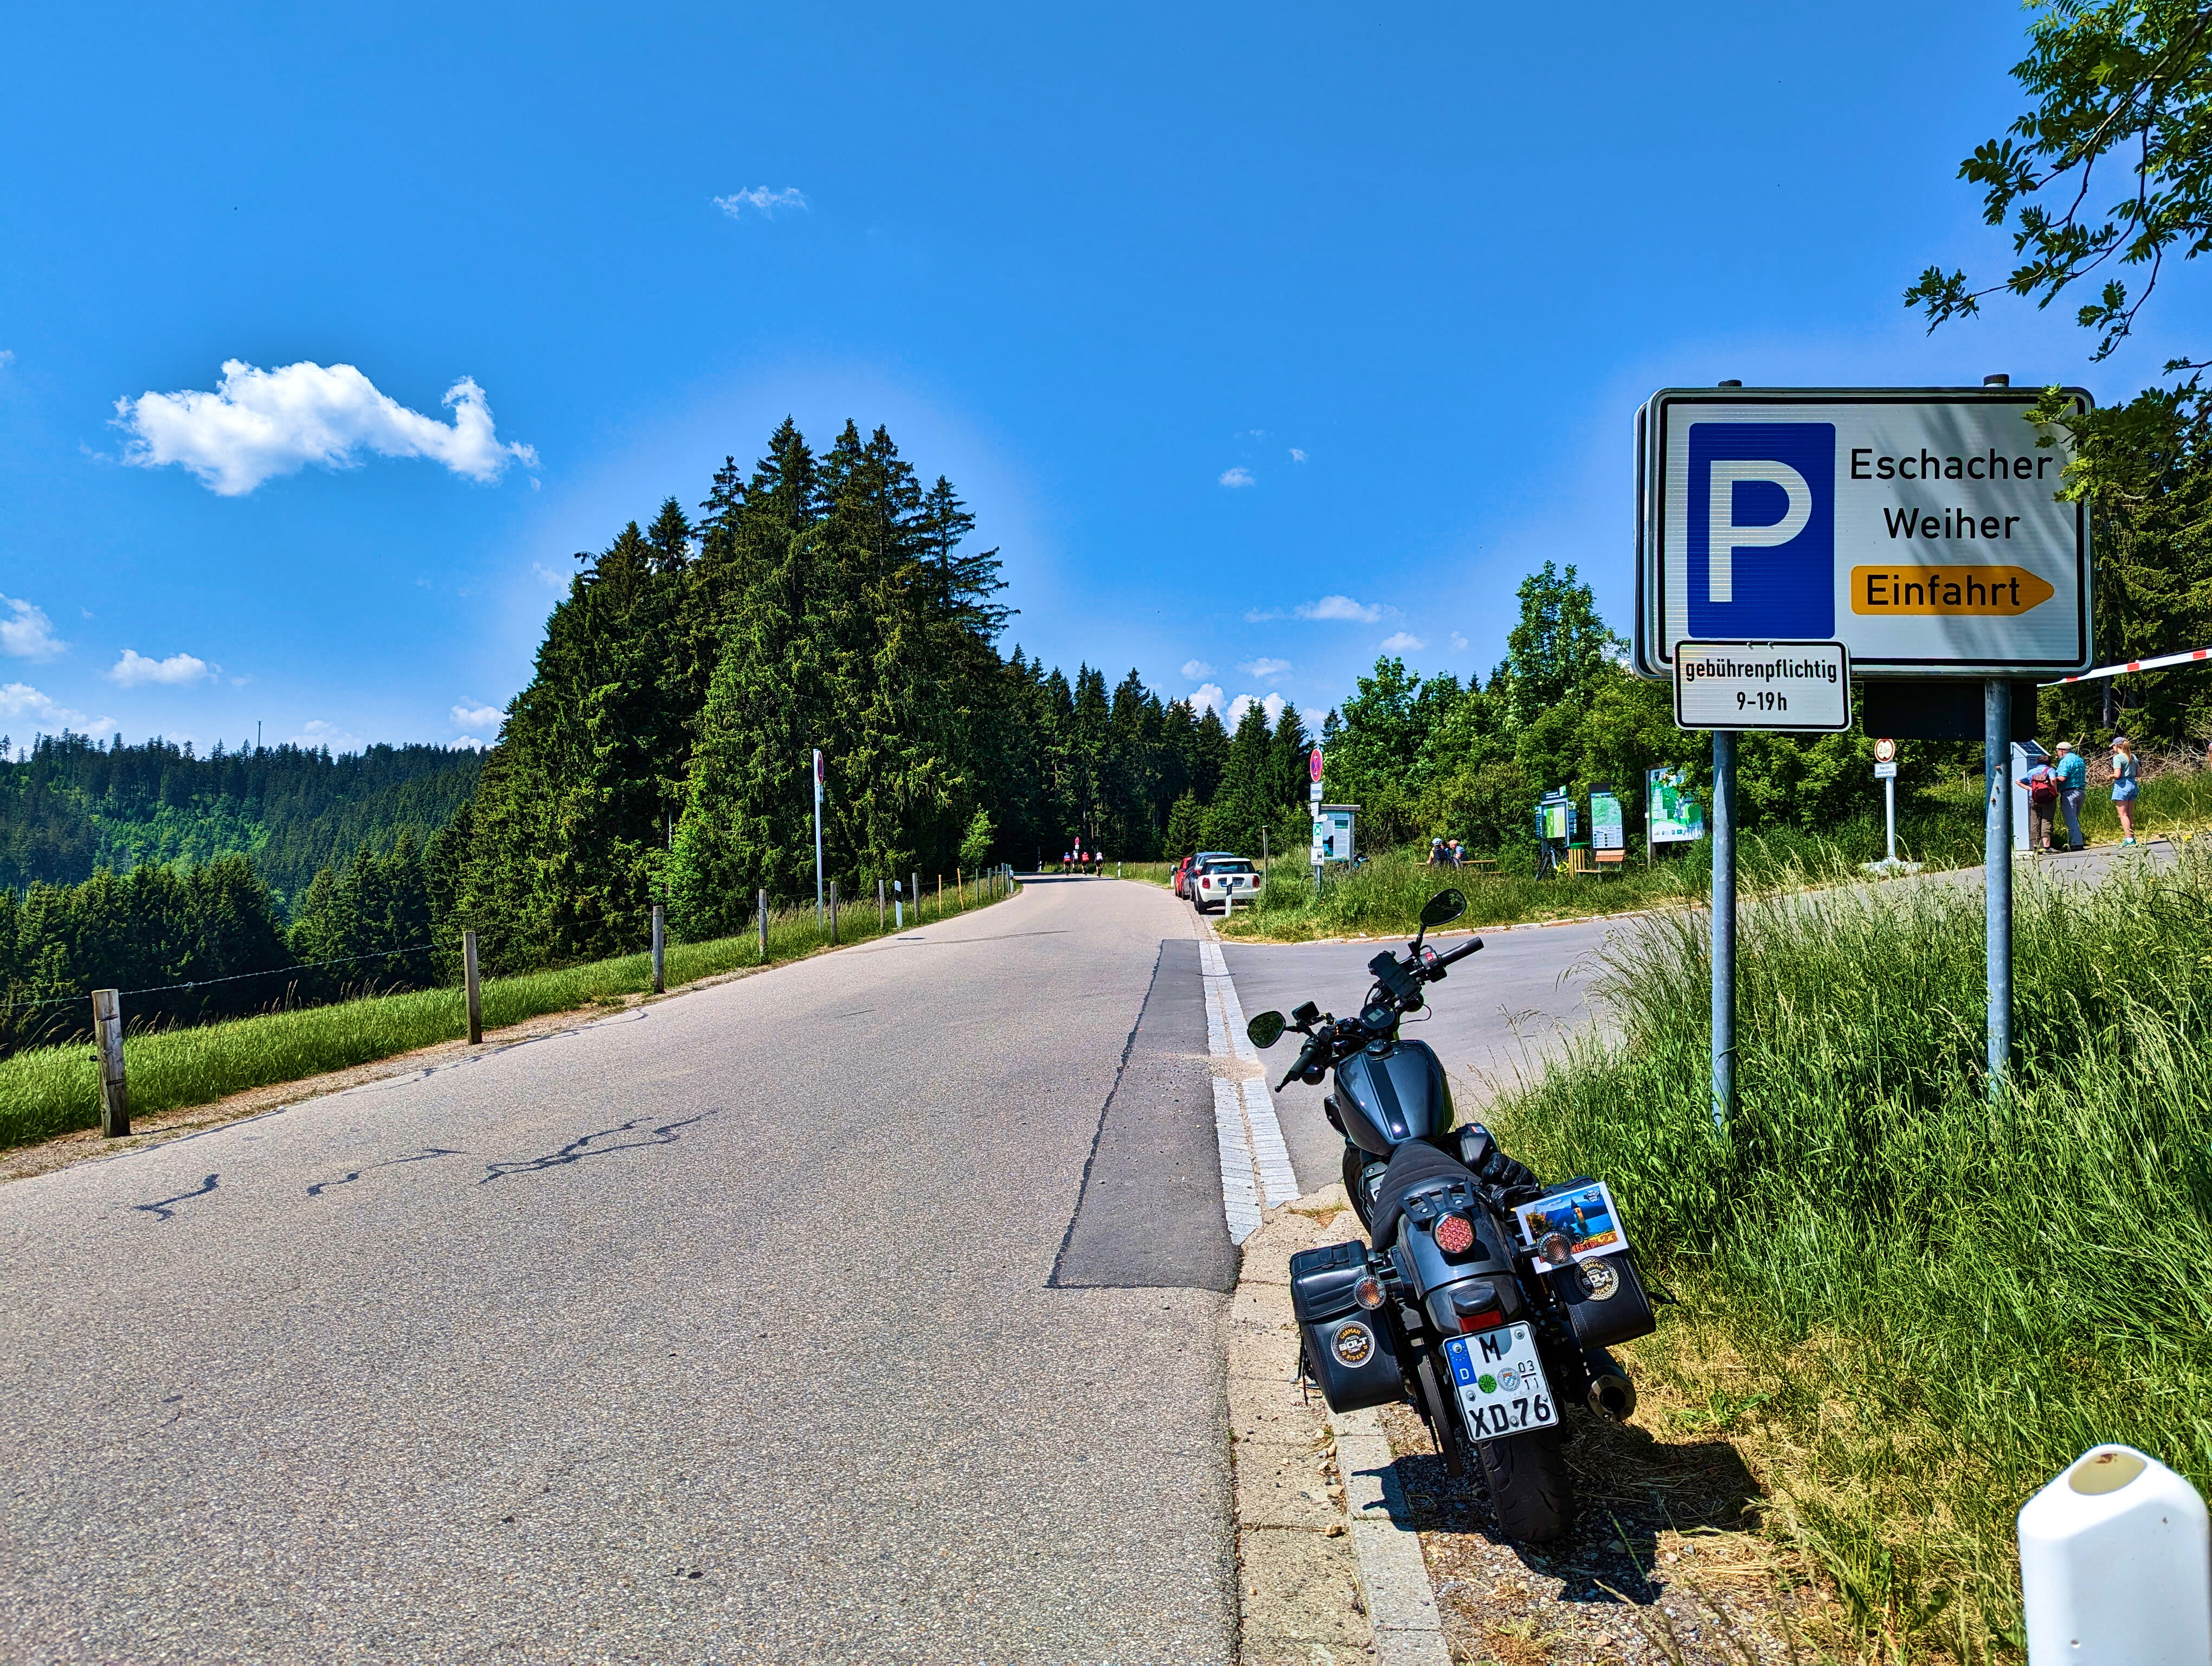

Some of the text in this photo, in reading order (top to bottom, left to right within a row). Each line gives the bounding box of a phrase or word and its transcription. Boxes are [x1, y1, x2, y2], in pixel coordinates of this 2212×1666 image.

[1851, 448, 2053, 480] Eschacher
[1709, 460, 1812, 603] P
[1883, 508, 2021, 539] Weiher
[1867, 574, 2021, 606] Einfahrt
[1686, 658, 1837, 683] gebührenpflichtig
[1338, 1336, 1367, 1351] BOLT
[1340, 1328, 1361, 1339] GERMAN
[1346, 1351, 1366, 1361] RIDERS
[1478, 1334, 1502, 1363] M
[1459, 1368, 1470, 1380] D
[1517, 1360, 1535, 1373] 03
[1524, 1377, 1539, 1390] 11
